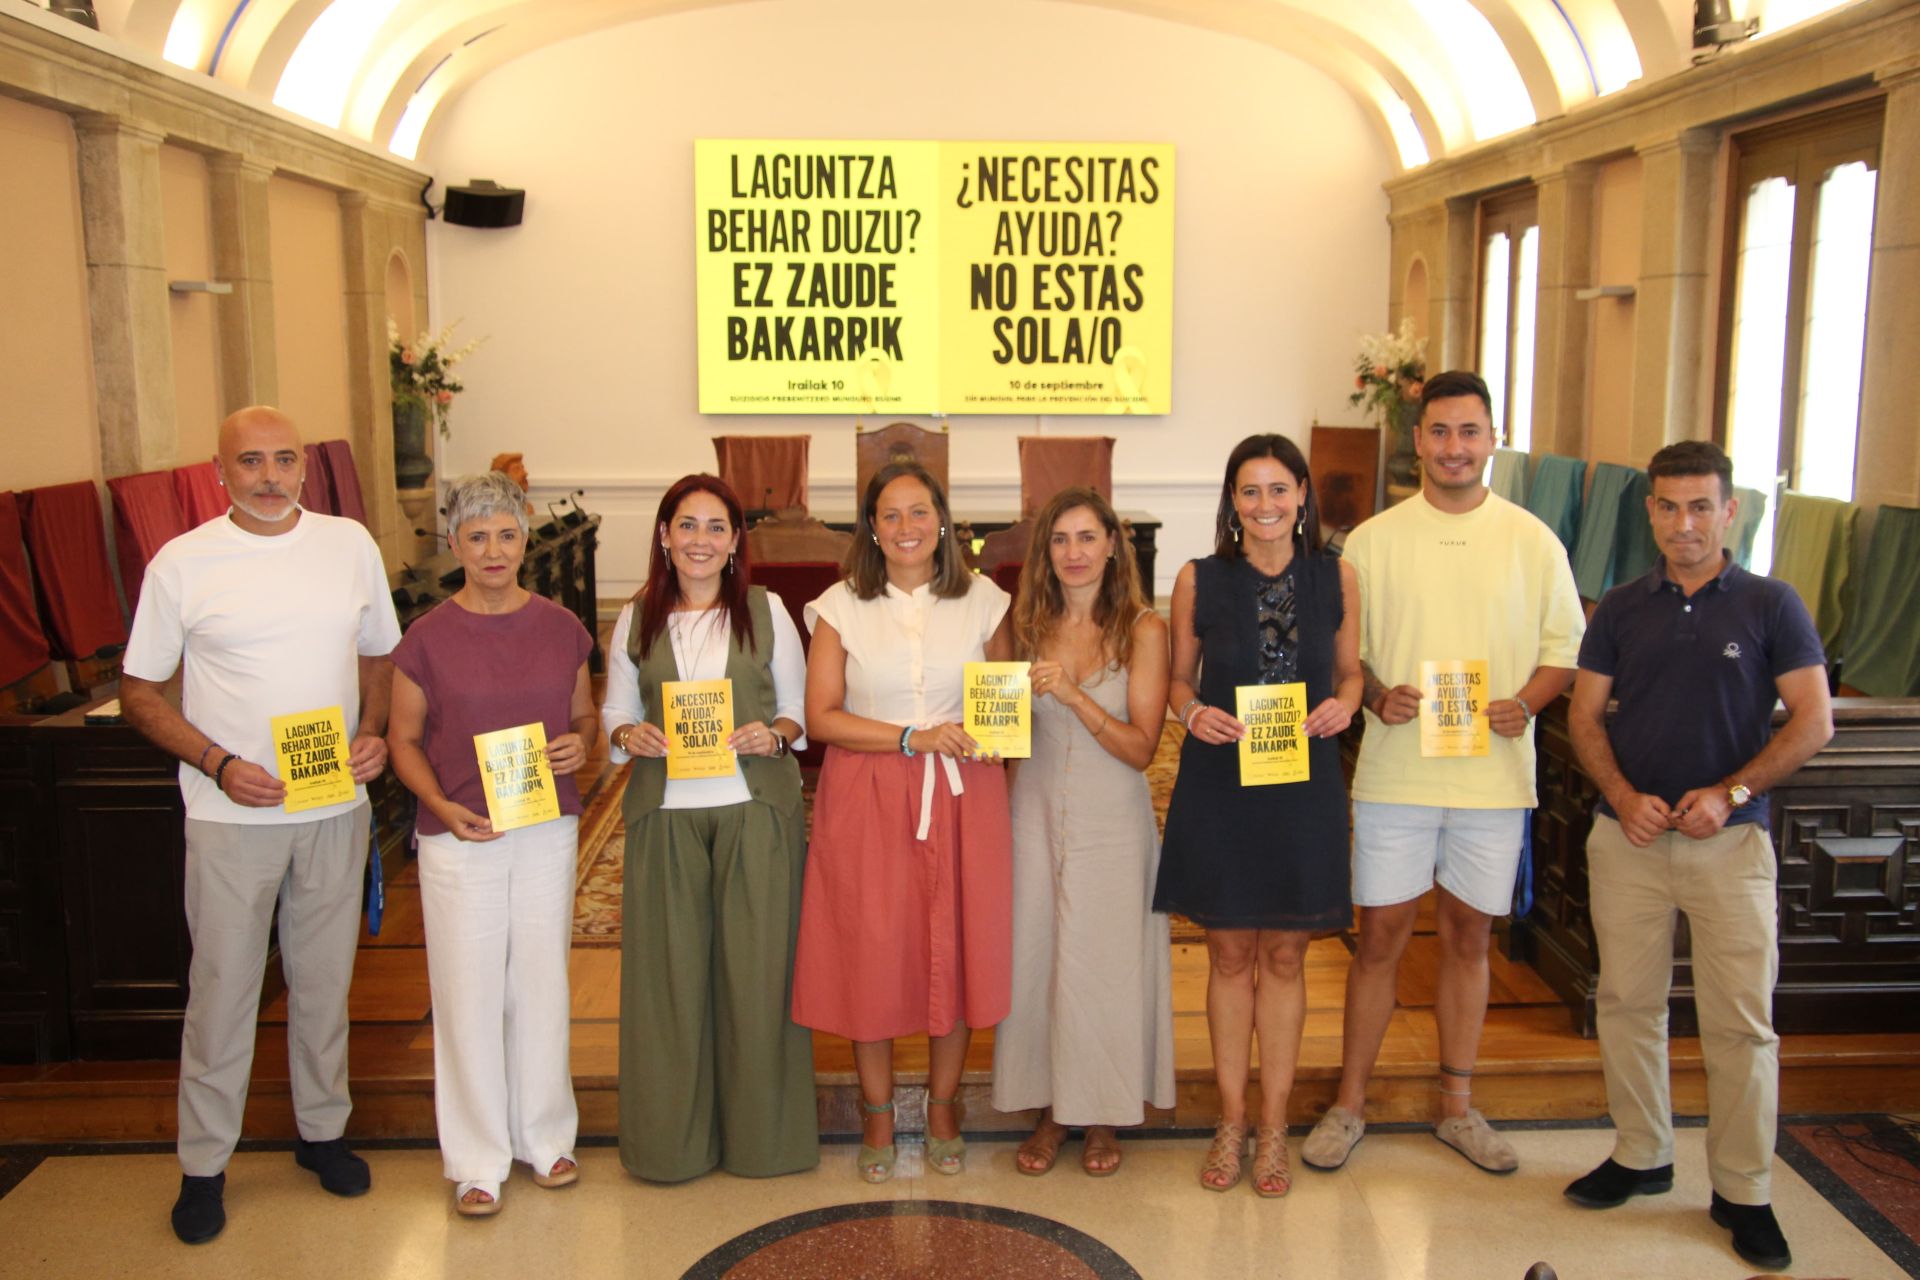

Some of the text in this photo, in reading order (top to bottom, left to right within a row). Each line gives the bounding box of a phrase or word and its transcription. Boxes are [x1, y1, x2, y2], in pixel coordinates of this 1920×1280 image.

[730, 154, 897, 200] LAGUNTZA
[956, 156, 1159, 208] ¿NECESITAS
[708, 209, 921, 254] BEHAR DUZU?
[993, 210, 1123, 257] AYUDA?
[733, 262, 897, 308] EZ ZAUDE
[970, 263, 1144, 312] NO ESTAS
[727, 316, 904, 361] BAKARRIK
[992, 316, 1122, 365] SOLA/O
[788, 379, 845, 391] Irailak 10
[1009, 380, 1104, 393] 10 de septiembre
[975, 675, 1019, 686] LAGUNTZA
[670, 691, 725, 709] ¿NECESITAS
[970, 688, 1024, 700] BEHAR DUZU?
[1437, 687, 1471, 699] AYUDA?
[976, 701, 1018, 713] EZ ZAUDE
[1249, 697, 1295, 711] LAGUNTZA
[1431, 699, 1478, 713] NO ESTAS
[681, 707, 715, 721] AYUDA?
[1245, 710, 1301, 726] BEHAR DUZU?
[1438, 714, 1472, 727] SOLA/O
[285, 720, 333, 739] LAGUNTZA
[676, 720, 723, 735] NO ESTAS
[1251, 725, 1296, 740] EZ ZAUDE
[281, 732, 340, 754] BEHAR DUZU?
[683, 734, 718, 748] SOLA/O
[290, 747, 336, 767] EZ ZAUDE
[494, 765, 539, 785] EZ ZAUDE
